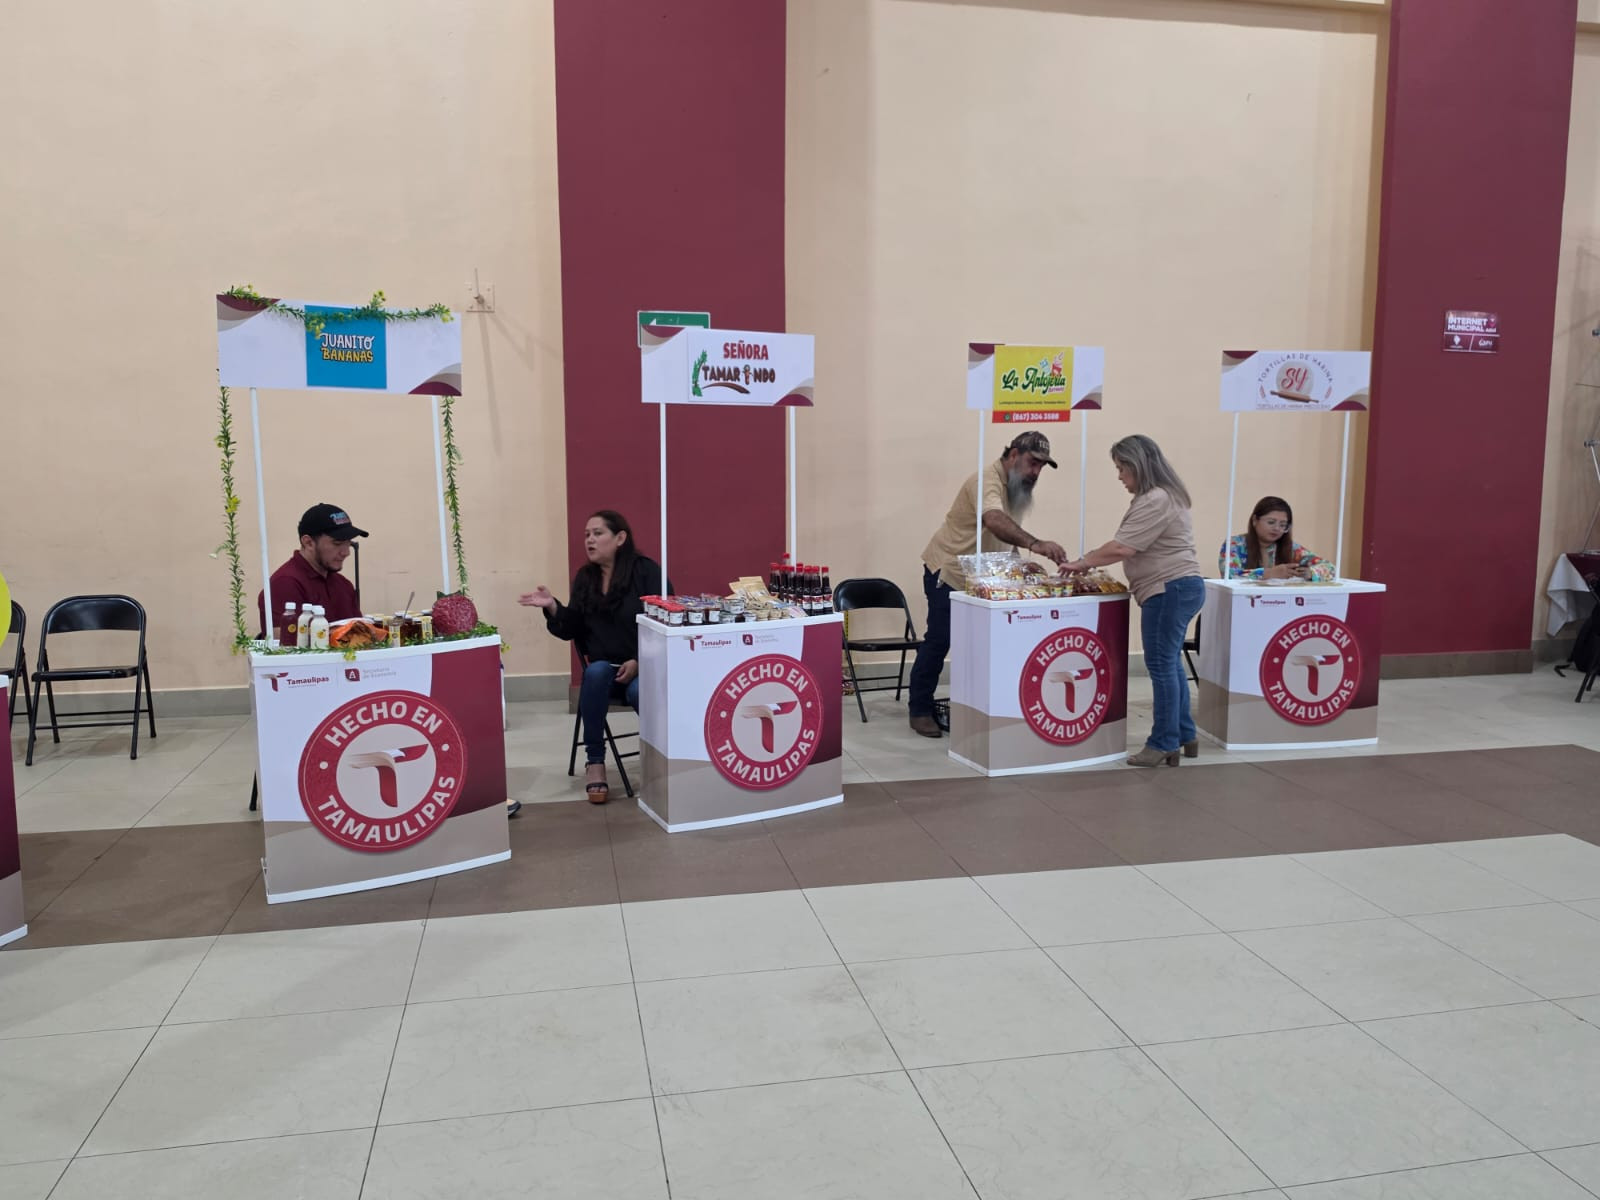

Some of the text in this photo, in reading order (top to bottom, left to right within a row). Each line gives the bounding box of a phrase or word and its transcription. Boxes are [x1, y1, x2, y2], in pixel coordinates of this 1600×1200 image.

[1448, 317, 1488, 326] INTERNET
[319, 332, 375, 350] JUANITO
[320, 347, 374, 362] BANANAS
[723, 340, 769, 360] SEÑORA
[1002, 370, 1019, 390] La
[1258, 353, 1296, 382] TORTILLAS
[701, 639, 732, 647] Tamaulipas
[1278, 622, 1351, 650] HECHO EN
[1036, 635, 1102, 666] HECHO EN
[286, 677, 329, 686] Tamaulipas
[725, 663, 808, 699] HECHO EN
[1269, 679, 1354, 719] TAMAULIPAS
[324, 701, 443, 747] HECHO EN
[1029, 693, 1106, 738] TAMAULIPAS
[717, 729, 815, 782] TAMAULIPAS
[318, 776, 455, 843] TAMAULIPAS
